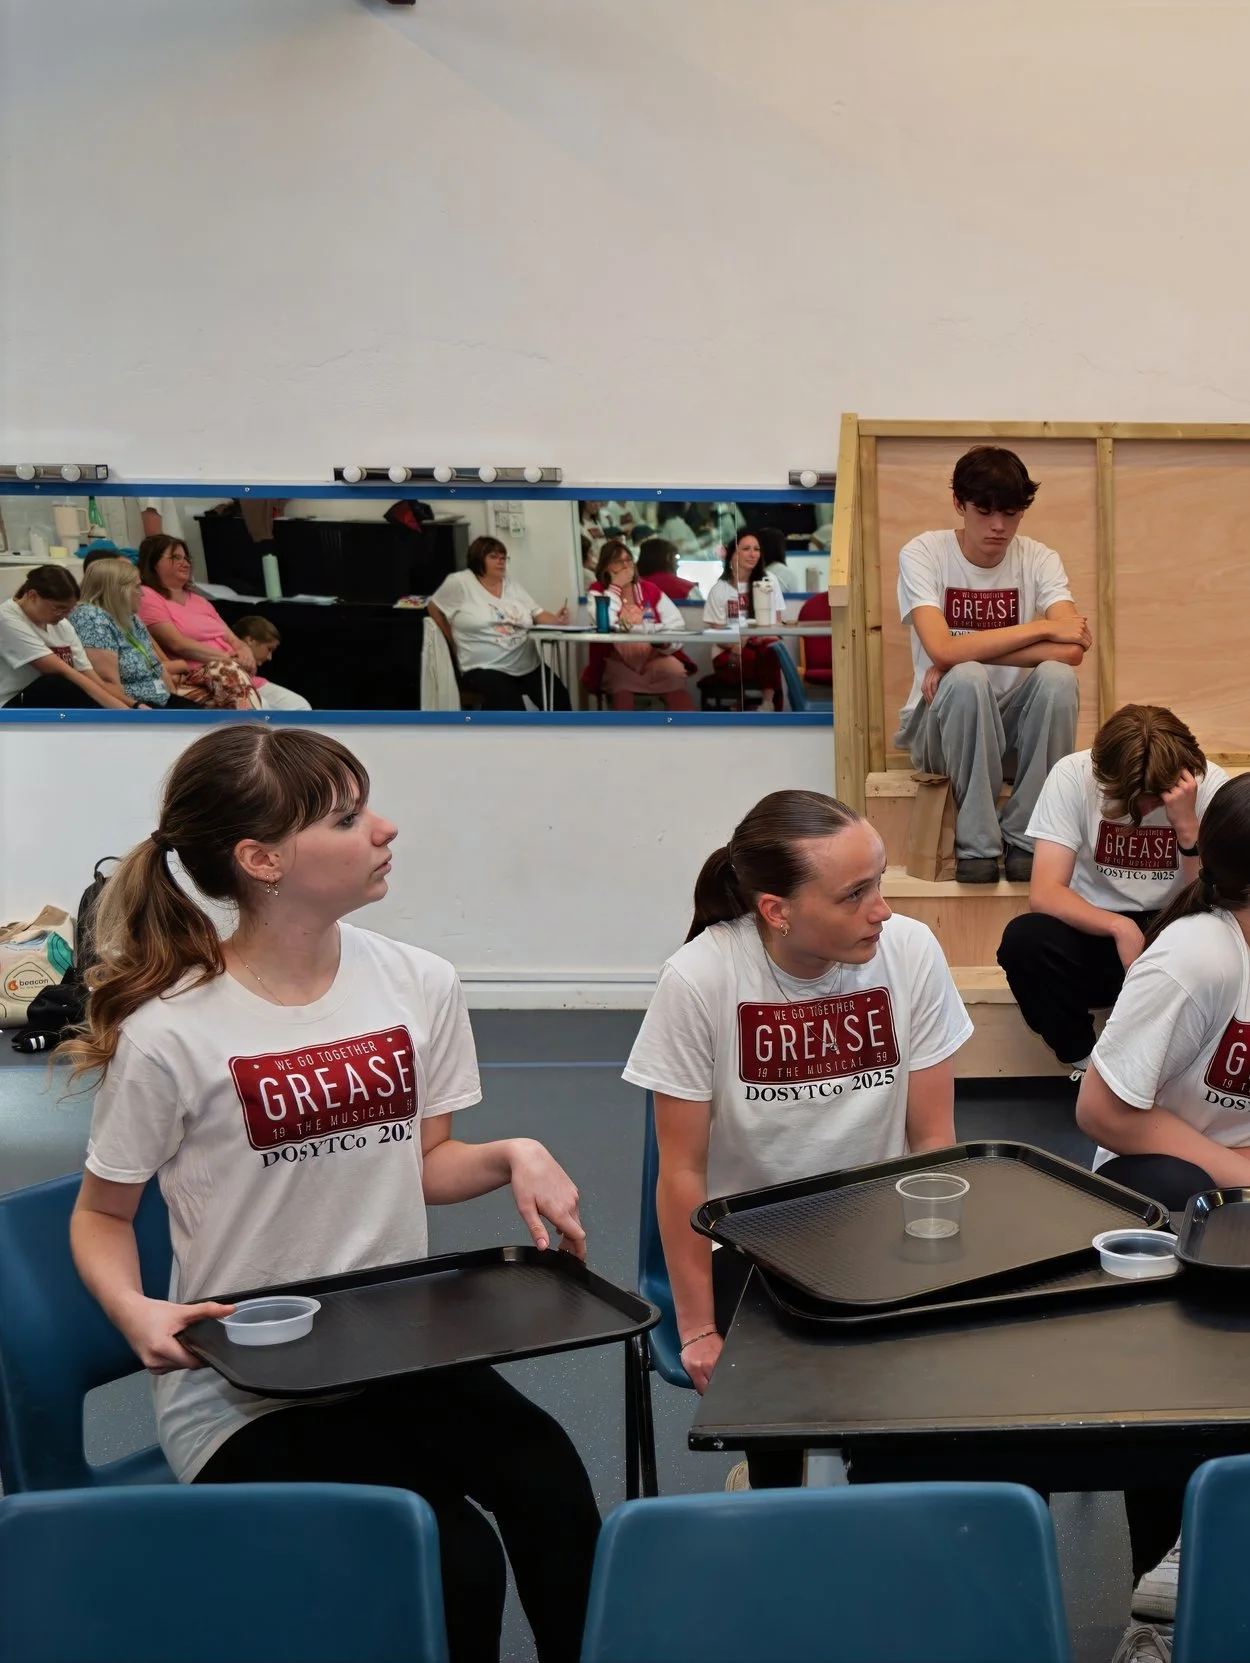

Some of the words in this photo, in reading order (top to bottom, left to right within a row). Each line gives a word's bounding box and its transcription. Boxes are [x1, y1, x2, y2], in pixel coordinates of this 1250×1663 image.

[952, 598, 1016, 620] GREASE
[1105, 833, 1174, 859] GREASE
[1151, 871, 1175, 880] 2025
[773, 1009, 787, 1021] WE
[791, 1007, 805, 1020] GO
[755, 1009, 885, 1062] GREASE
[274, 1058, 293, 1071] WE
[298, 1054, 314, 1067] GO
[316, 1040, 378, 1064] TOGETHER
[757, 1067, 768, 1078] 19
[777, 1066, 799, 1078] THE
[807, 1055, 864, 1075] MUSICAL
[876, 1051, 888, 1063] 59
[258, 1049, 413, 1122] GREASE
[745, 1082, 843, 1102] DOSYTCo
[851, 1069, 895, 1091] 2025
[272, 1126, 286, 1141] 19
[296, 1118, 322, 1135] THE
[330, 1103, 396, 1127] MUSICAL
[260, 1133, 367, 1169] DOSYTCo
